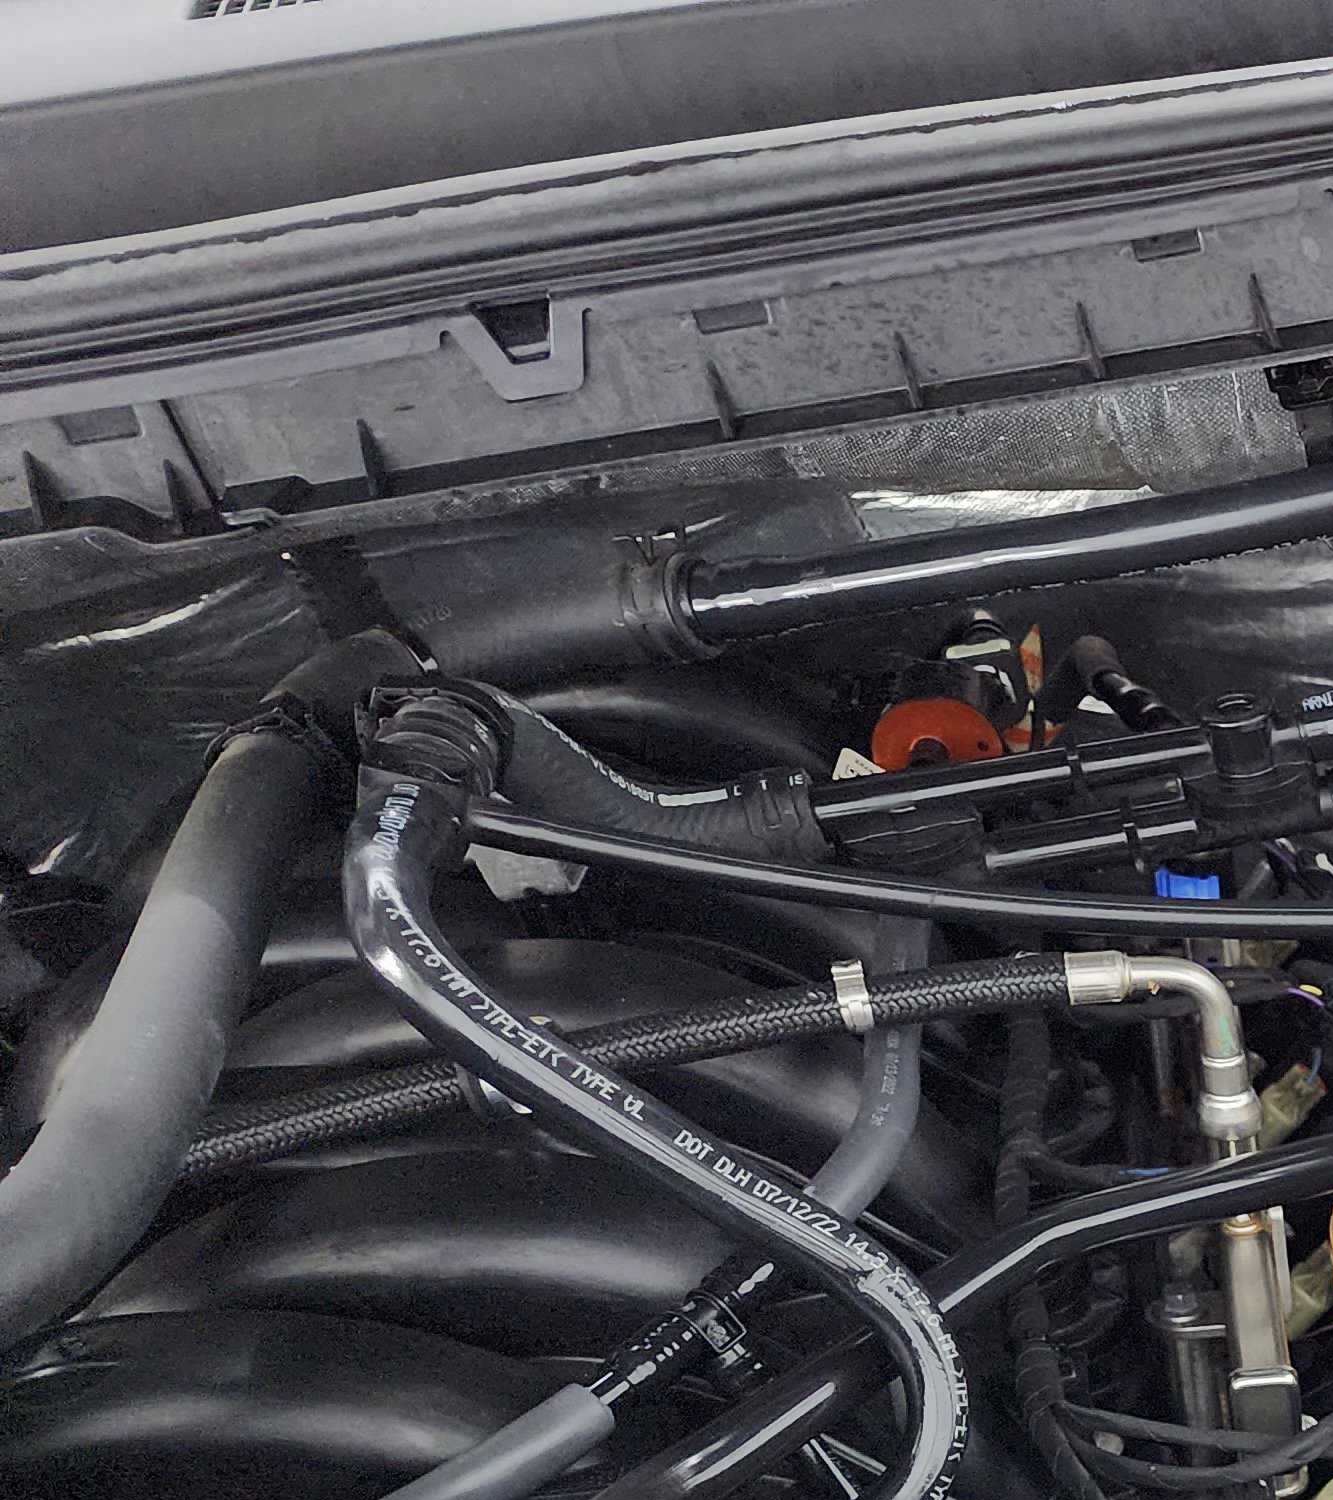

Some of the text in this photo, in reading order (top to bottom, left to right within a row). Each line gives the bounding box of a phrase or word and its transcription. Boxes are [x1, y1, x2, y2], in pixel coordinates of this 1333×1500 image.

[570, 1060, 622, 1101] TYPE
[673, 1128, 715, 1162] DOT
[712, 1155, 754, 1189] DLH
